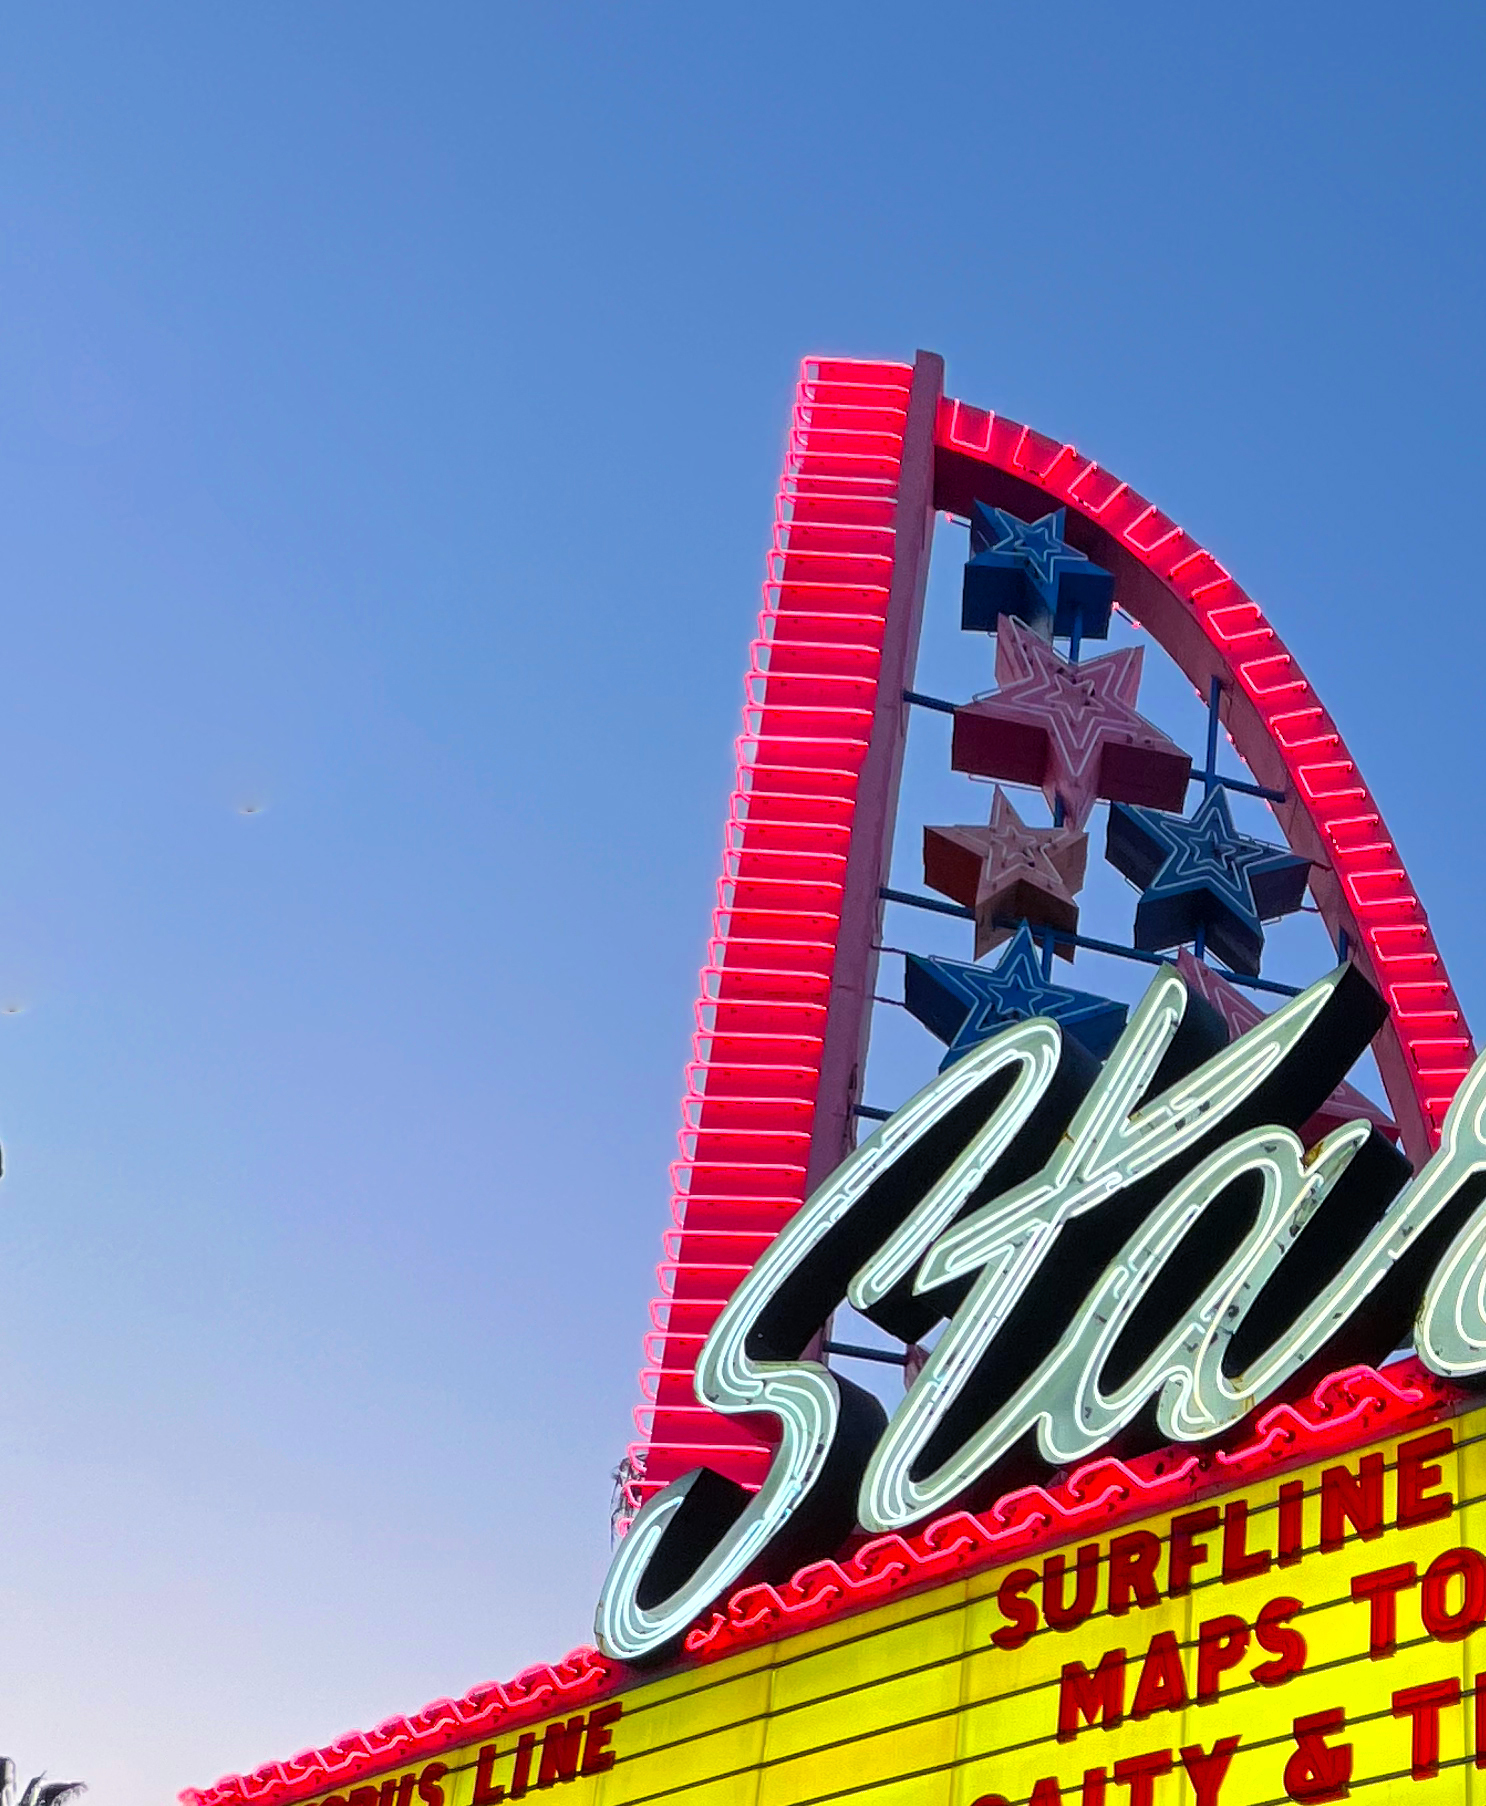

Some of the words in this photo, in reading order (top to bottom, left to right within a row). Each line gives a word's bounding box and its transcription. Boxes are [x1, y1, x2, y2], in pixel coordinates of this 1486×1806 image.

[990, 1427, 1455, 1652] SURFLINE
[1056, 1595, 1309, 1743] MAPS
[1283, 1707, 1354, 1806] &
